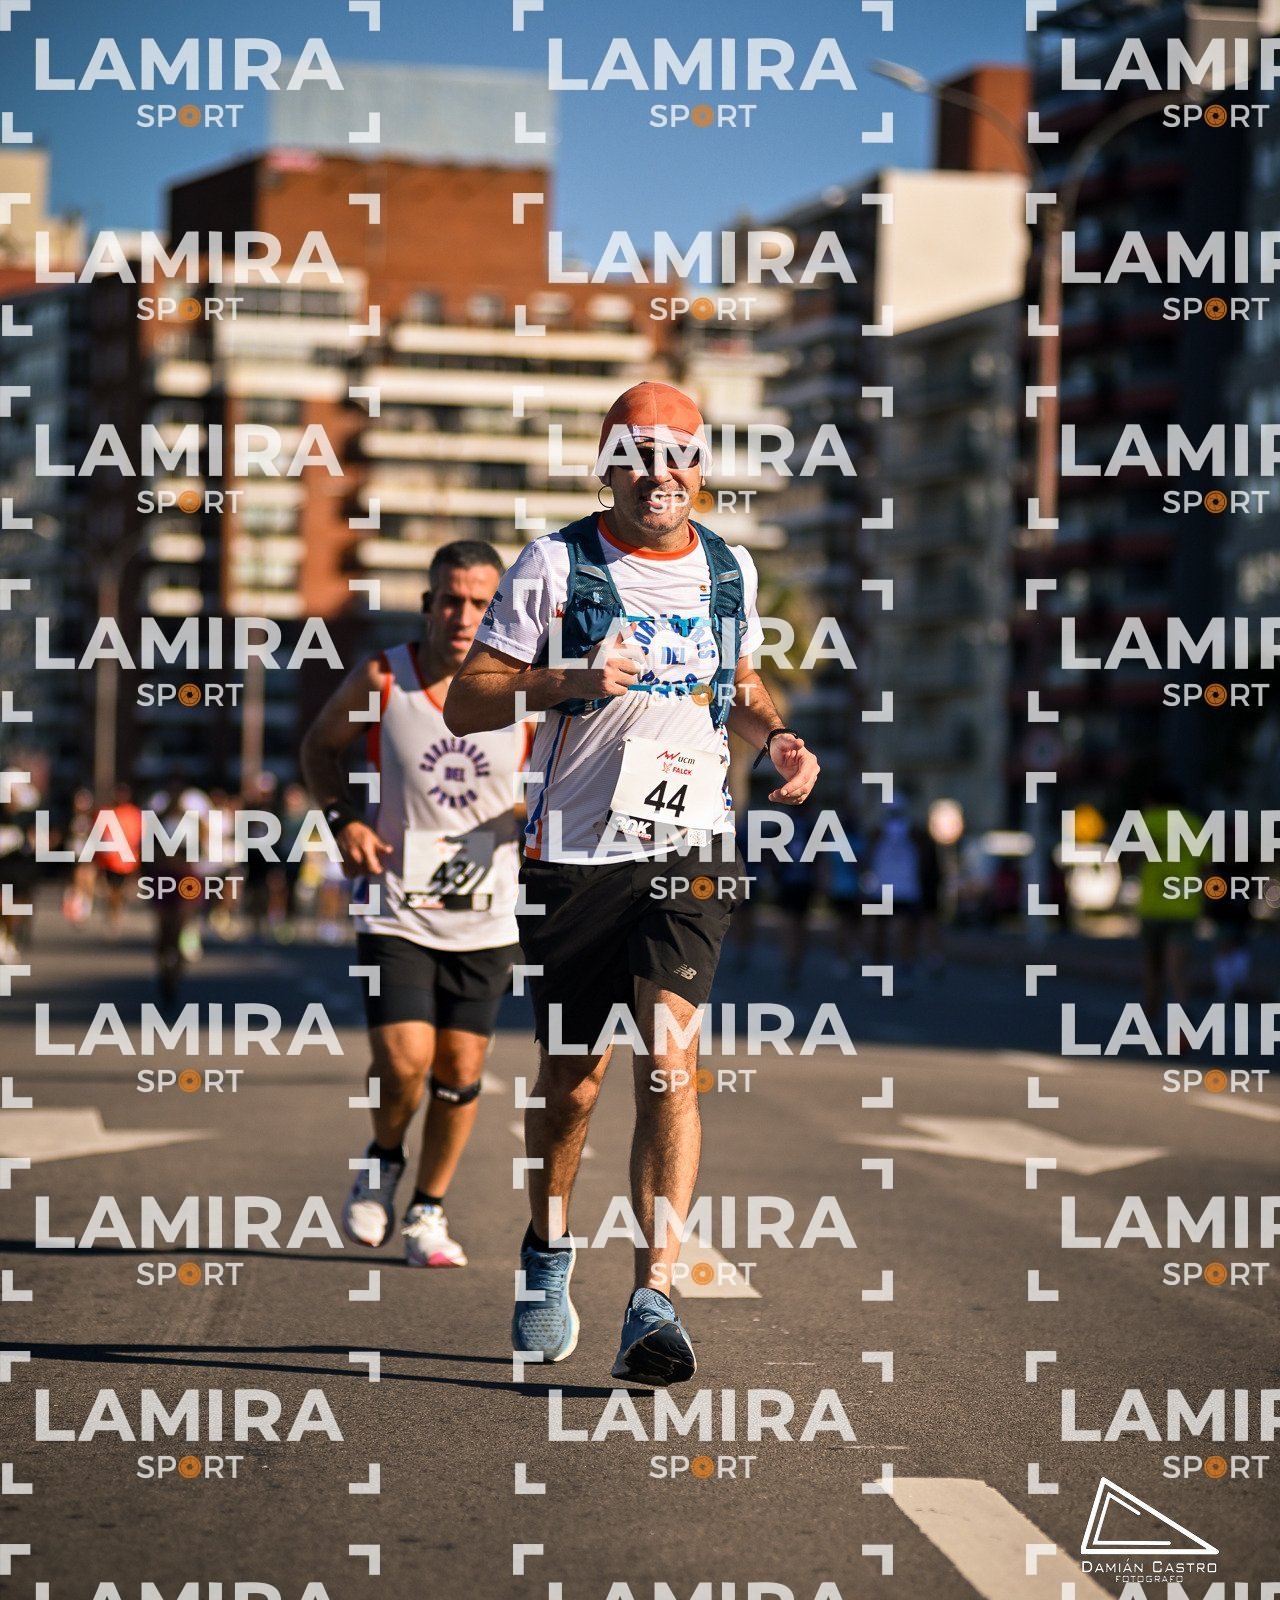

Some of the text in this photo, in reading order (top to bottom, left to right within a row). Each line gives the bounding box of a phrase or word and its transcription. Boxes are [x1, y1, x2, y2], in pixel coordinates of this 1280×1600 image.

[660, 646, 686, 665] DEL
[677, 756, 696, 765] ucm
[672, 766, 693, 776] FALCK
[644, 780, 688, 818] 44
